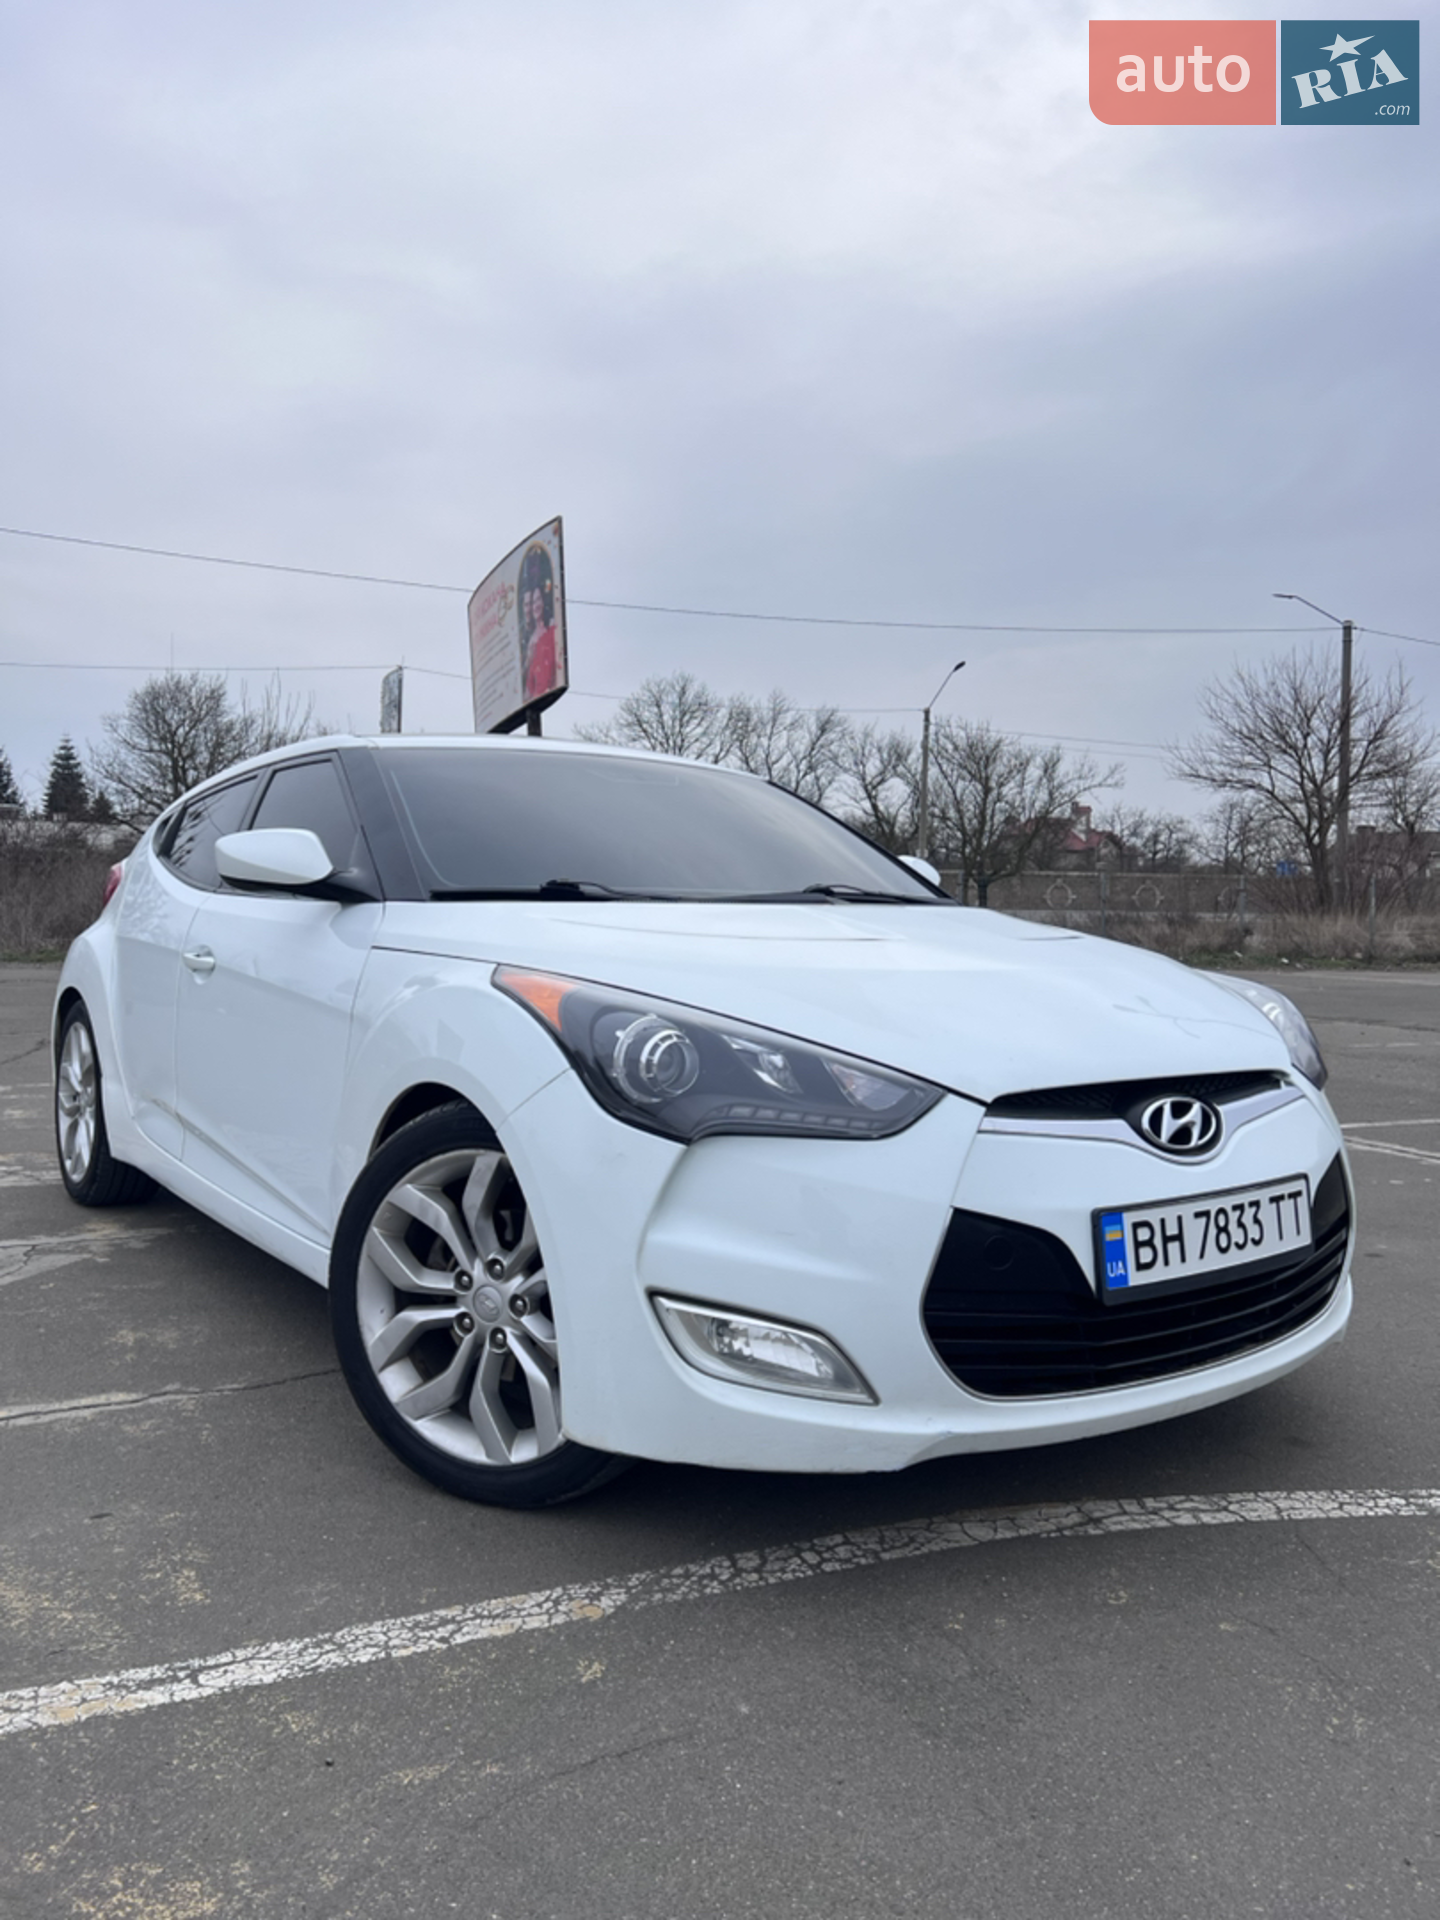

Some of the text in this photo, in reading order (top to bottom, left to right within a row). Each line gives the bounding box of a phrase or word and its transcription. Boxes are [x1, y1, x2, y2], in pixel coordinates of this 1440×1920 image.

[1131, 1190, 1303, 1272] BH 7833 TT
[1107, 1260, 1126, 1277] UA
